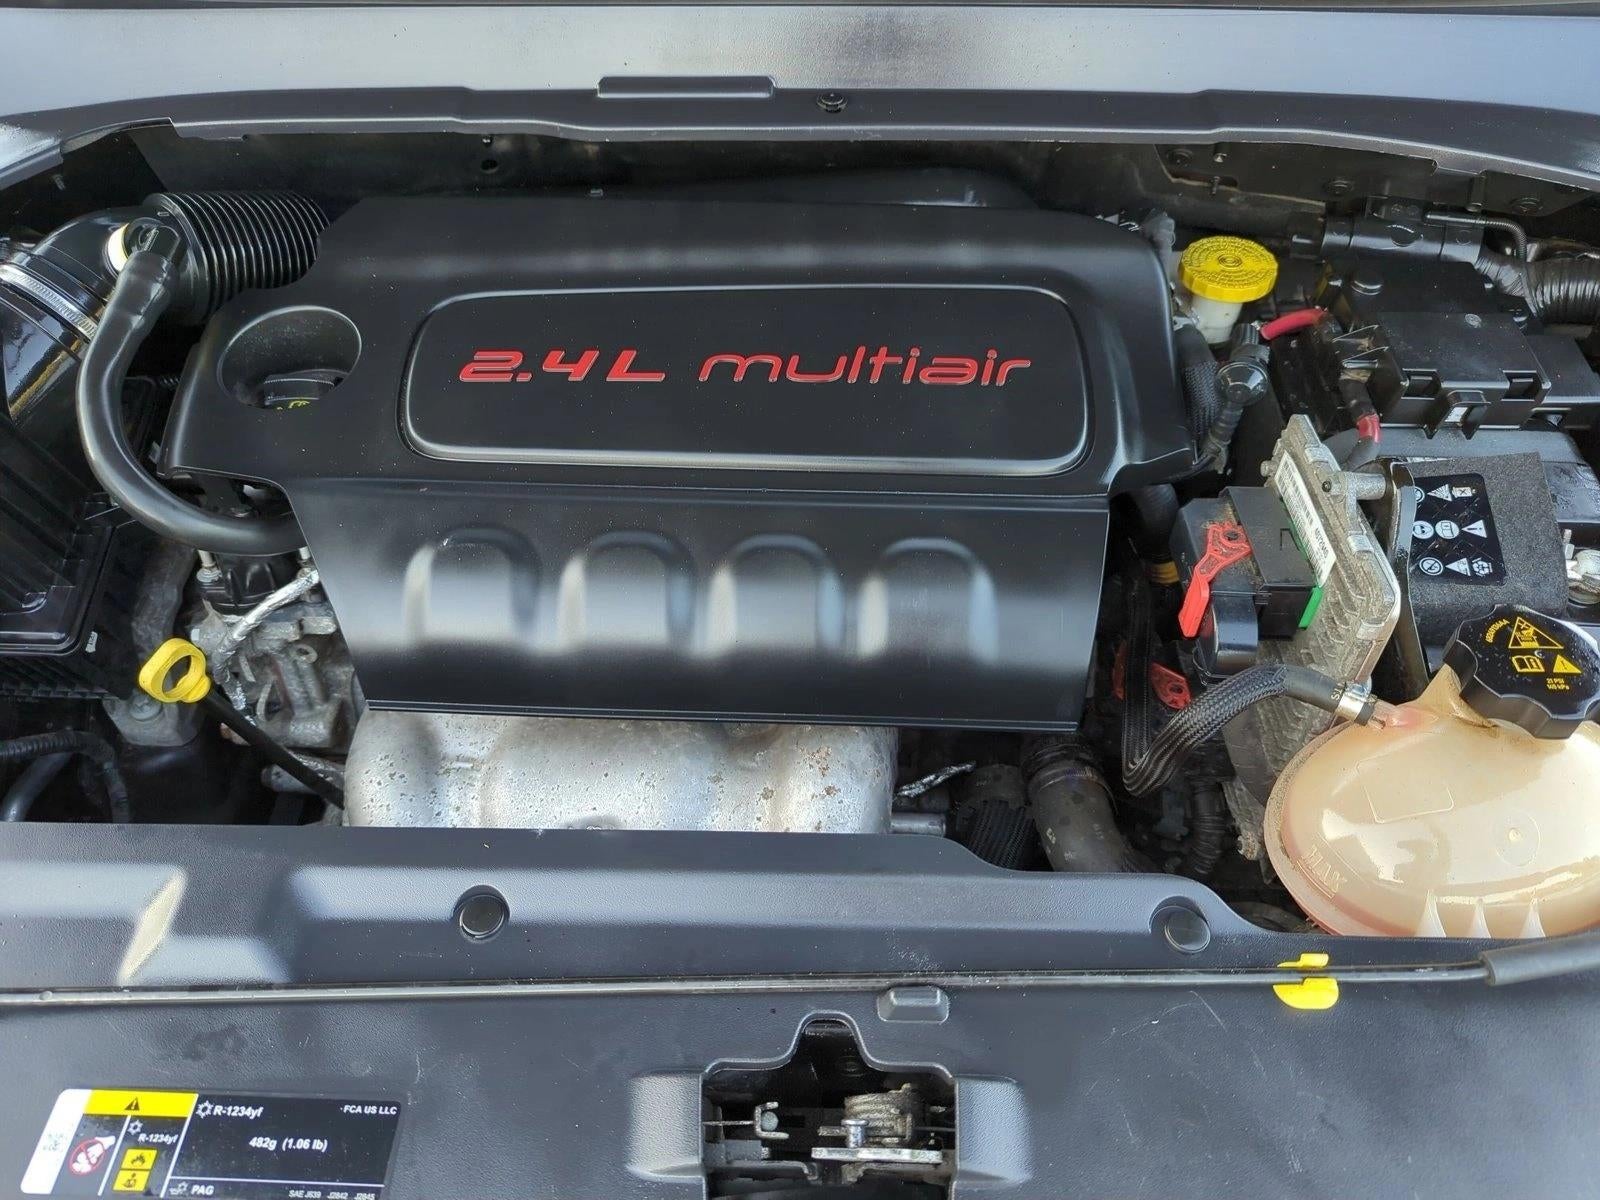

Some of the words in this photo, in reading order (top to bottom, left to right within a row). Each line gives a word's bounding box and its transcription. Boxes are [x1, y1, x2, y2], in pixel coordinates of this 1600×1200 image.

[699, 345, 1032, 385] multiair
[212, 1104, 264, 1120] R-1234yf
[343, 1105, 362, 1114] FCA
[364, 1105, 377, 1114] US
[379, 1106, 397, 1115] LLC
[138, 1133, 179, 1145] R-1234yf
[249, 1136, 277, 1151] 482g
[282, 1138, 310, 1151] (1.06
[191, 1184, 215, 1196] PAG
[288, 1189, 304, 1198] SAE
